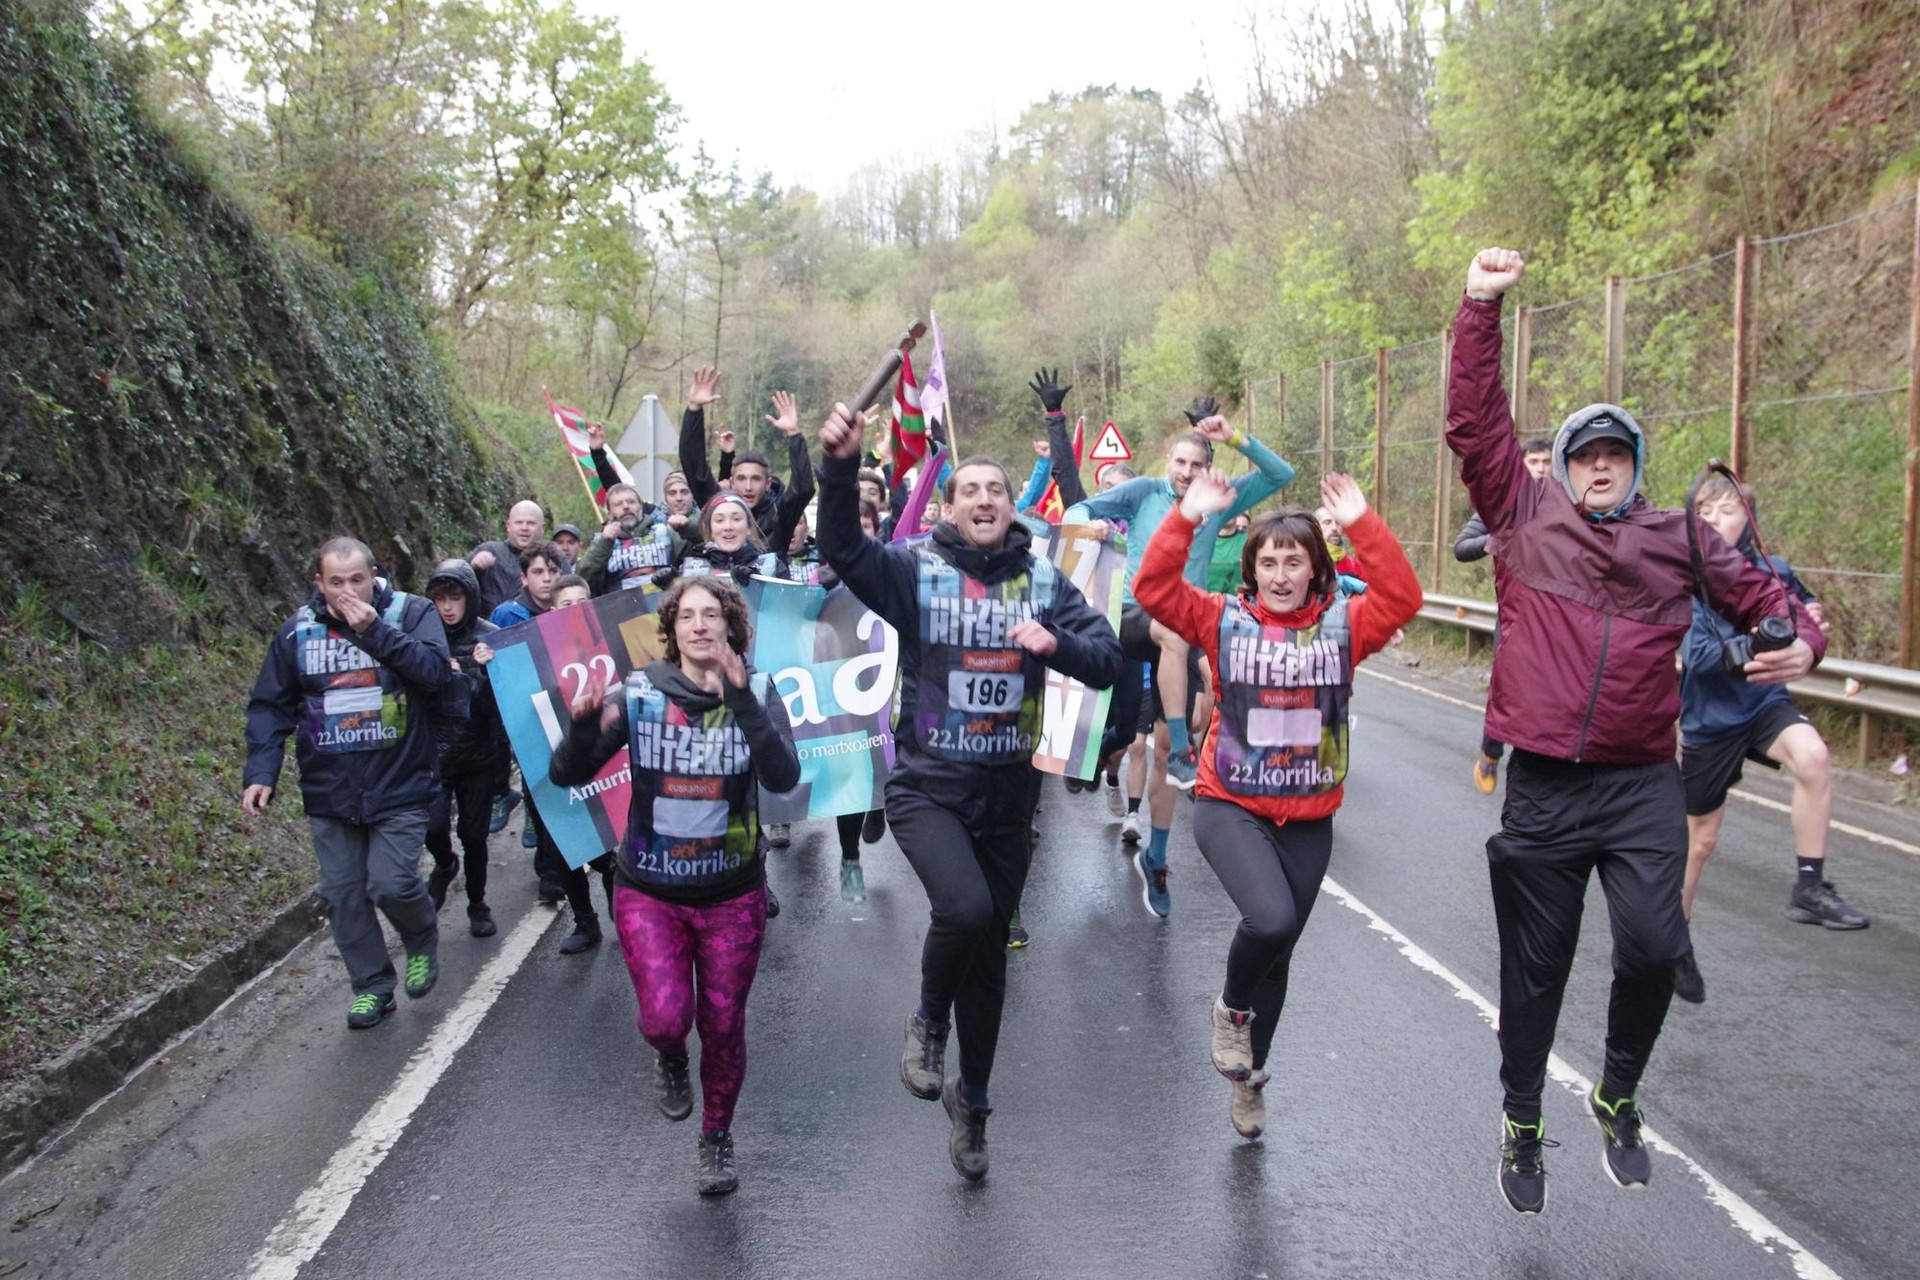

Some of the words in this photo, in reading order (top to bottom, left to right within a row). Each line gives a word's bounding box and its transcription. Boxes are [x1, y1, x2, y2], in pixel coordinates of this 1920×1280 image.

[1230, 636, 1341, 687] HITZEKIN
[966, 677, 1008, 706] 196
[812, 733, 888, 758] martxoaren
[569, 763, 632, 805] Amurri
